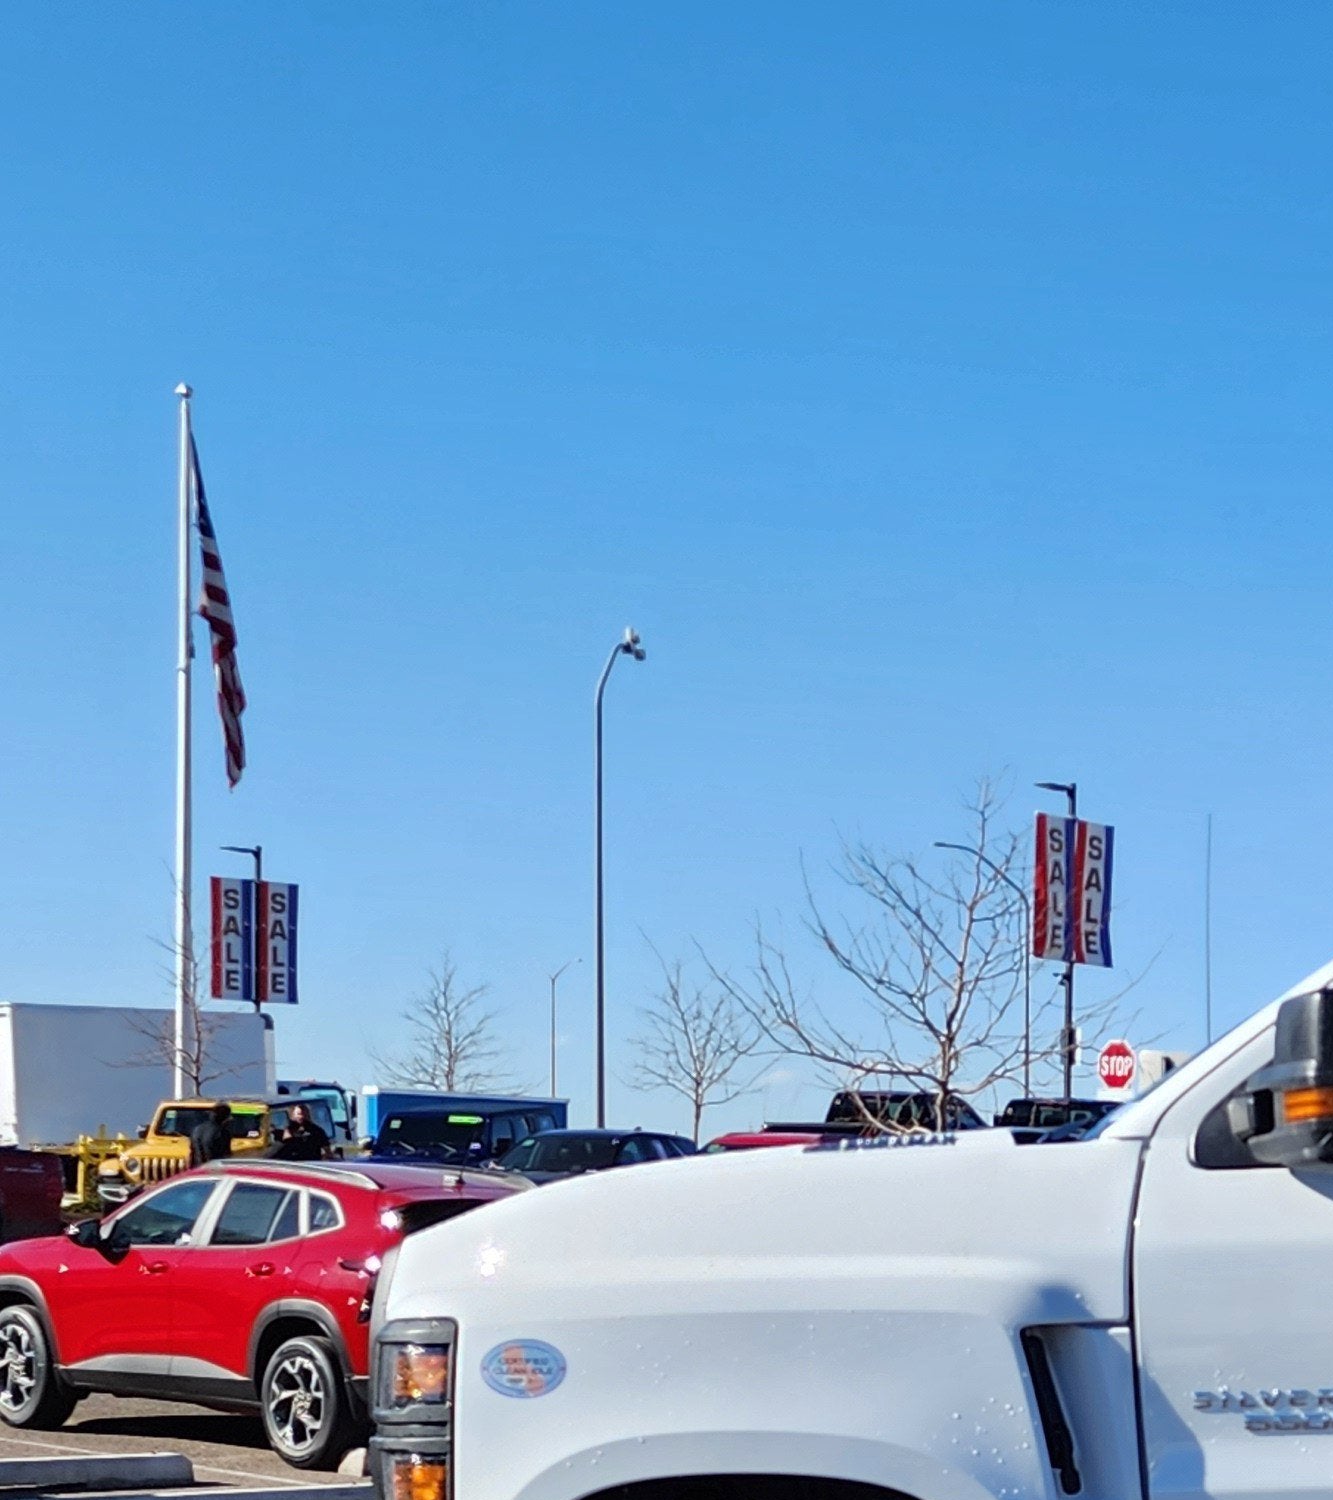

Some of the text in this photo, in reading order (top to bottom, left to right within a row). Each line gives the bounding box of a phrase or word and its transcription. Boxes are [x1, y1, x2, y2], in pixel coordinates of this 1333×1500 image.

[223, 888, 241, 991] SALE
[1048, 828, 1065, 951] SALE
[1084, 835, 1103, 955] SALE
[270, 892, 287, 994] SALE
[1101, 1055, 1133, 1077] STOP
